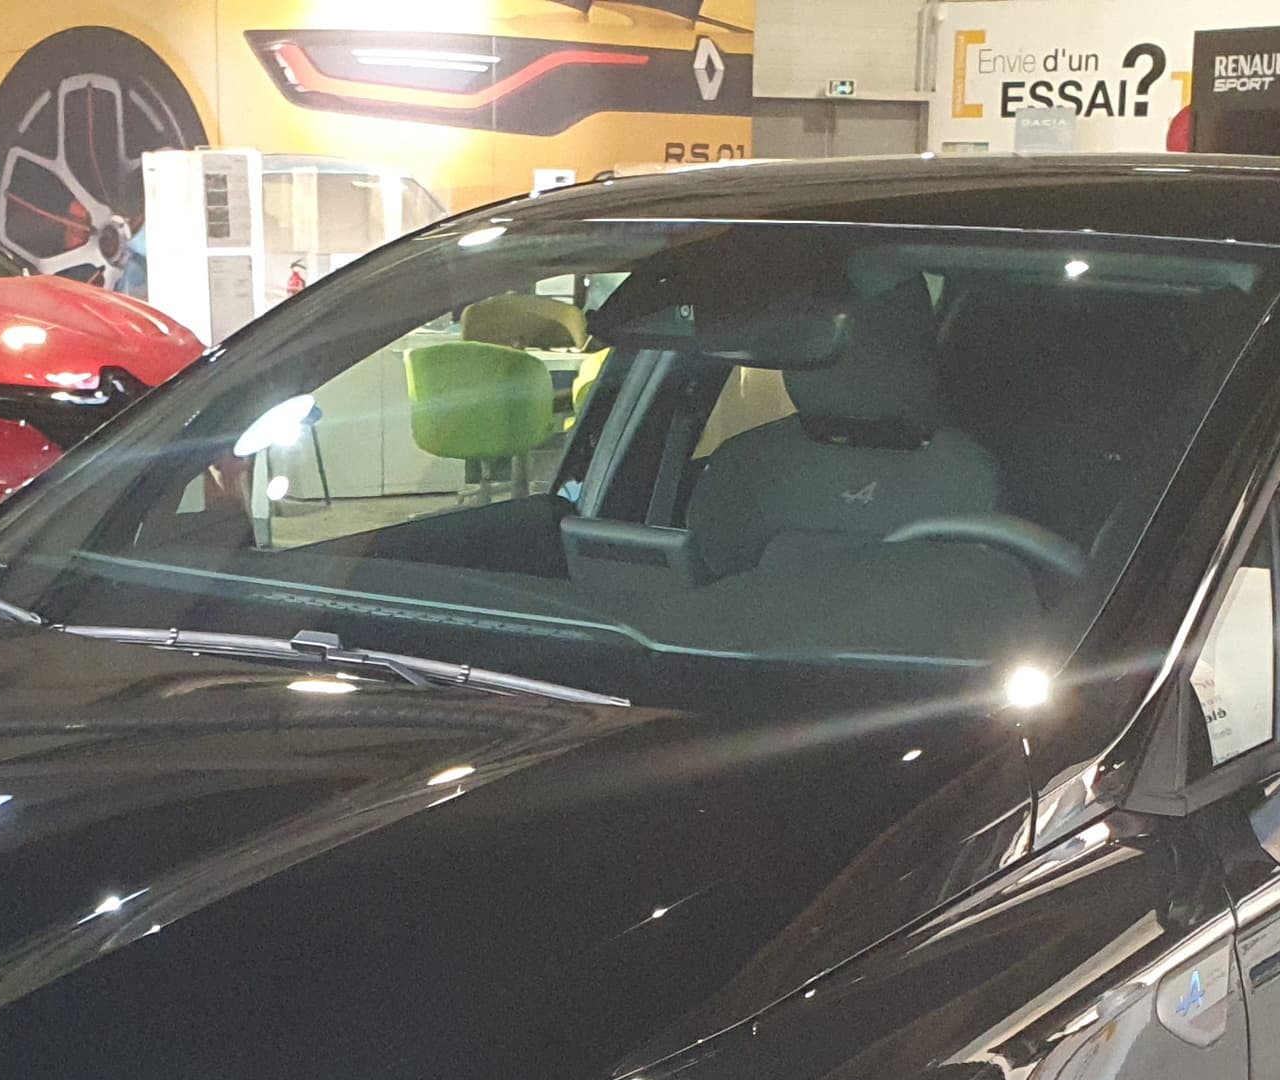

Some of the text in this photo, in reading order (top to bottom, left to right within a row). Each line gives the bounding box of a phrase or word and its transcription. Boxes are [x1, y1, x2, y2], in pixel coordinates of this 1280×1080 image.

[978, 48, 1099, 74] Envie d'un
[1213, 77, 1275, 93] SPORT
